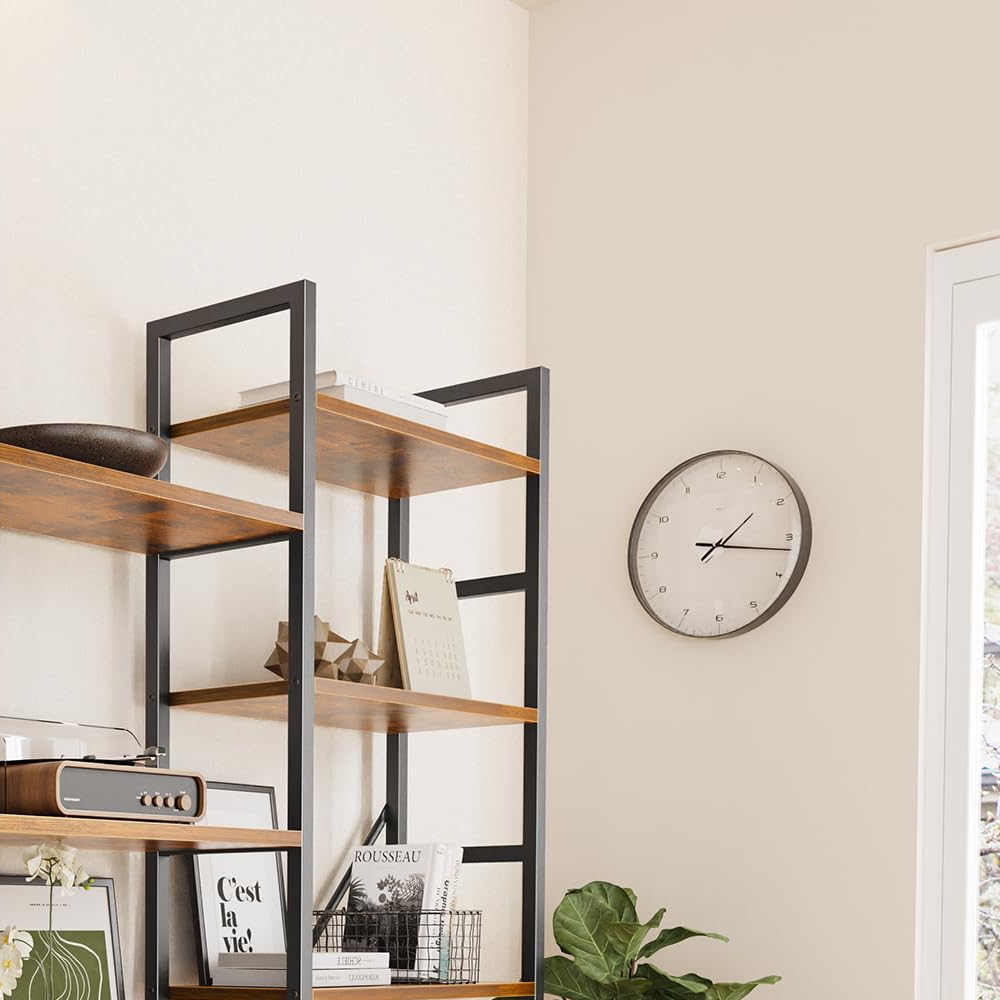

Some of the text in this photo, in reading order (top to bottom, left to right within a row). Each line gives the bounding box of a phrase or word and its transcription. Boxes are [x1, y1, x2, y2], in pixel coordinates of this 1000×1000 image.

[716, 471, 727, 480] 12
[776, 498, 785, 506] 2
[659, 516, 670, 524] 10
[785, 533, 793, 541] 3
[651, 552, 659, 560] 9
[775, 571, 783, 579] 4
[683, 608, 690, 616] 7
[715, 614, 724, 622] 6
[354, 850, 422, 863] ROUSSEAU
[217, 876, 262, 903] C'est
[219, 902, 238, 928] la
[223, 928, 254, 953] vie!
